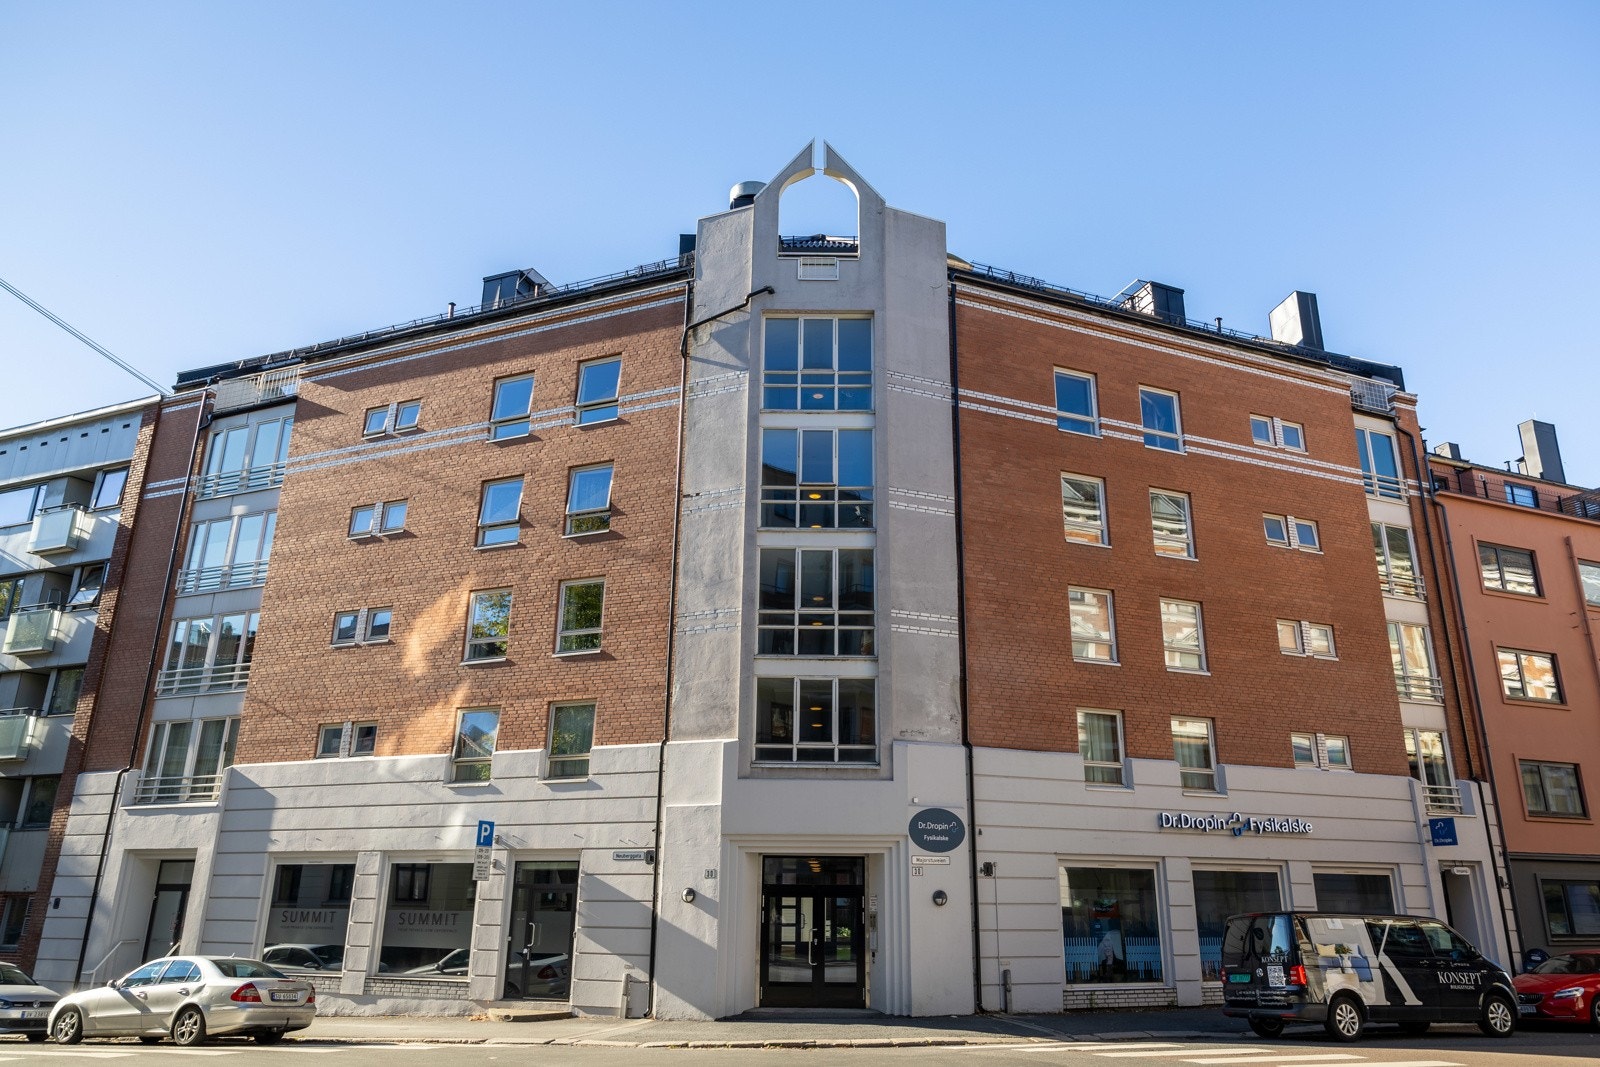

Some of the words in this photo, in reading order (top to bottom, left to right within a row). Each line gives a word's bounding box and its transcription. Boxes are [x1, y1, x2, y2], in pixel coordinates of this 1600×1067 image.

[918, 821, 949, 831] Dr.Dropin
[1160, 812, 1226, 832] Dr.Dropin
[1249, 817, 1313, 834] Fysikalske
[480, 823, 491, 843] P
[281, 910, 337, 923] SUMMIT
[398, 912, 459, 926] SUMMIT
[1437, 971, 1482, 985] KONSEPT
